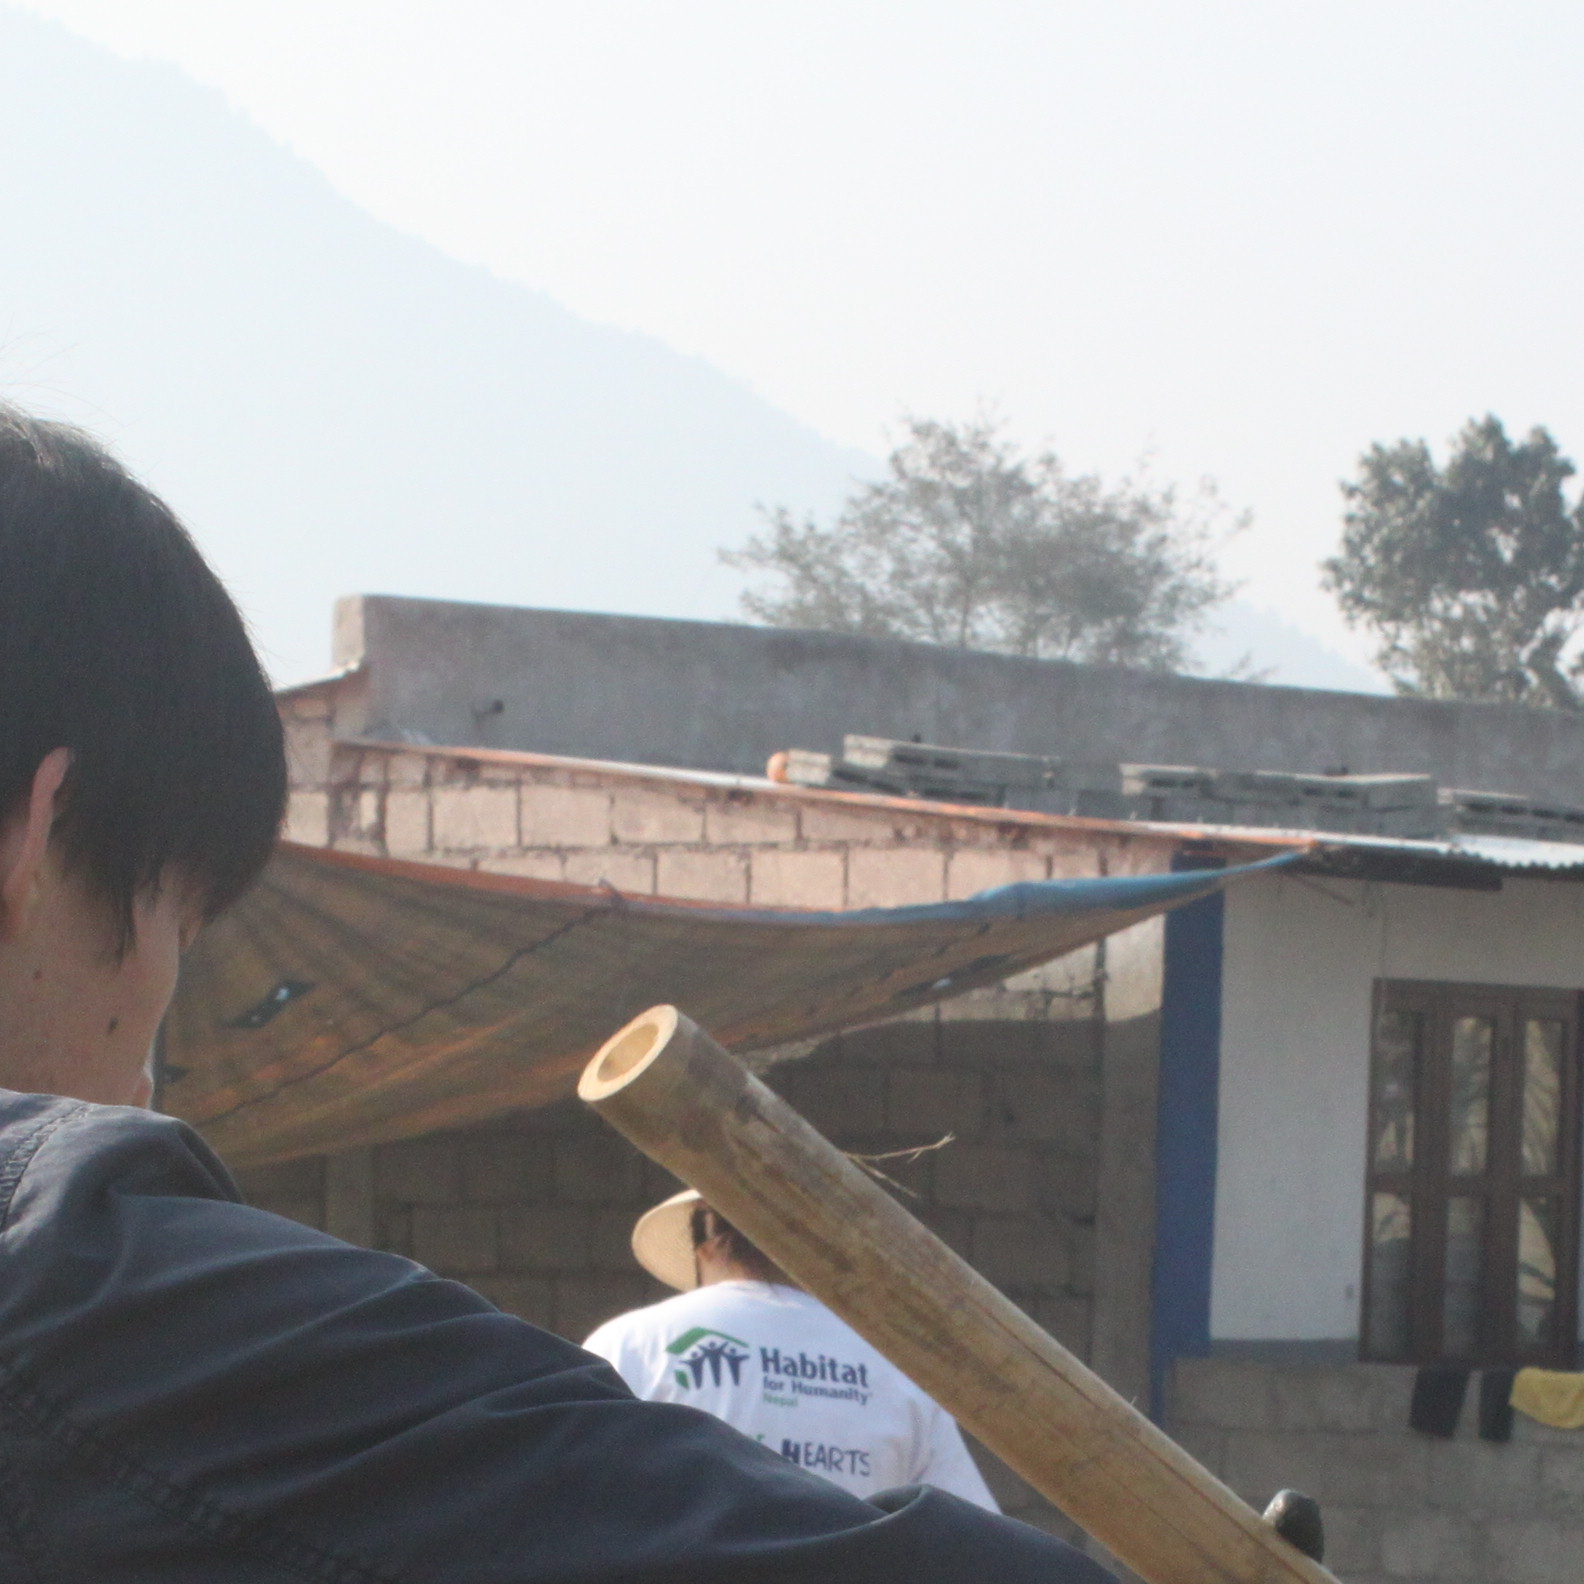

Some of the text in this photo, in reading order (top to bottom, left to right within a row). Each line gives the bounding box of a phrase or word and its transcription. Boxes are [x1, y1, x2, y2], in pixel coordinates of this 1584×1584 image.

[759, 1347, 869, 1388] Habitat
[763, 1375, 870, 1406] for Humanity
[781, 1438, 871, 1477] HEARTS
